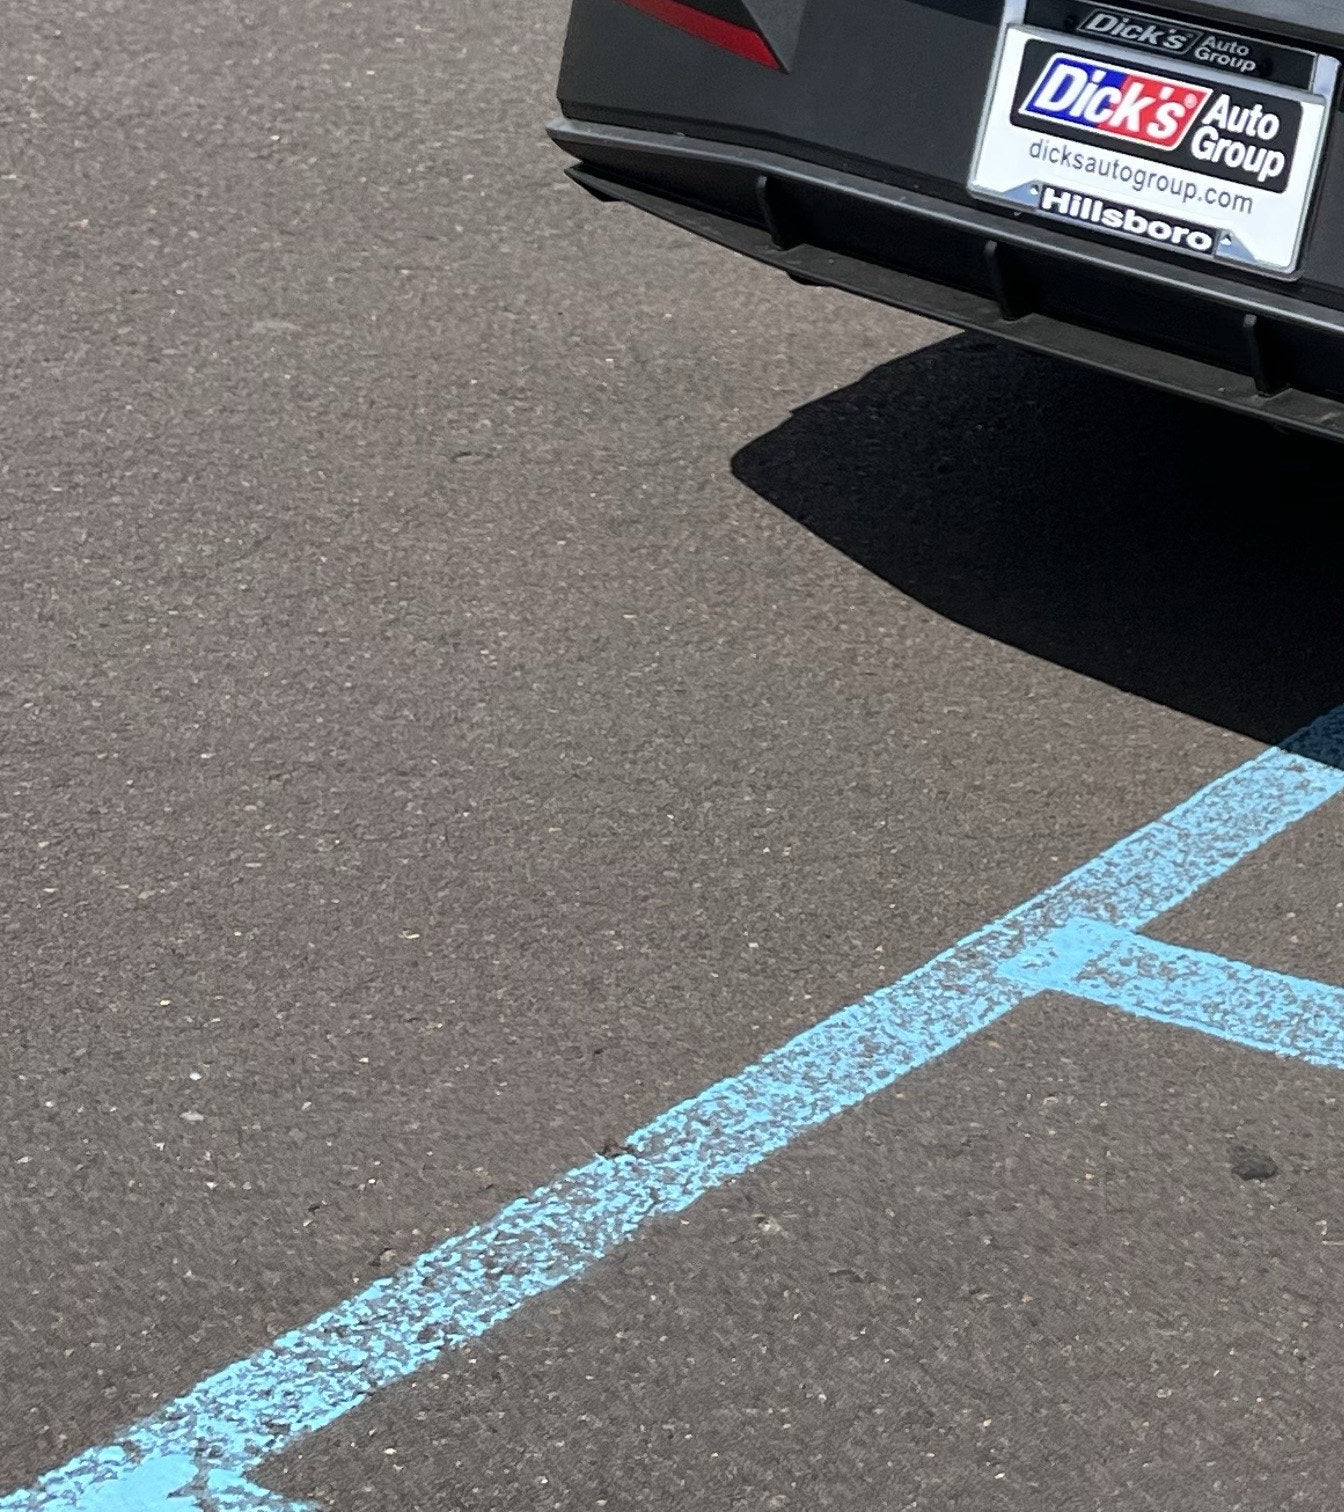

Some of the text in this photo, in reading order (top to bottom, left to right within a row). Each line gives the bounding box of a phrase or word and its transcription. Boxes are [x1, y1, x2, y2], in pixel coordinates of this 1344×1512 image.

[1084, 10, 1251, 58] Dick's Auto
[1193, 46, 1257, 73] Group
[1033, 63, 1280, 141] Dick's Auto
[1028, 138, 1254, 215] dicksautogroup.com
[1190, 125, 1286, 183] Group
[1040, 186, 1214, 251] Hillsboro
